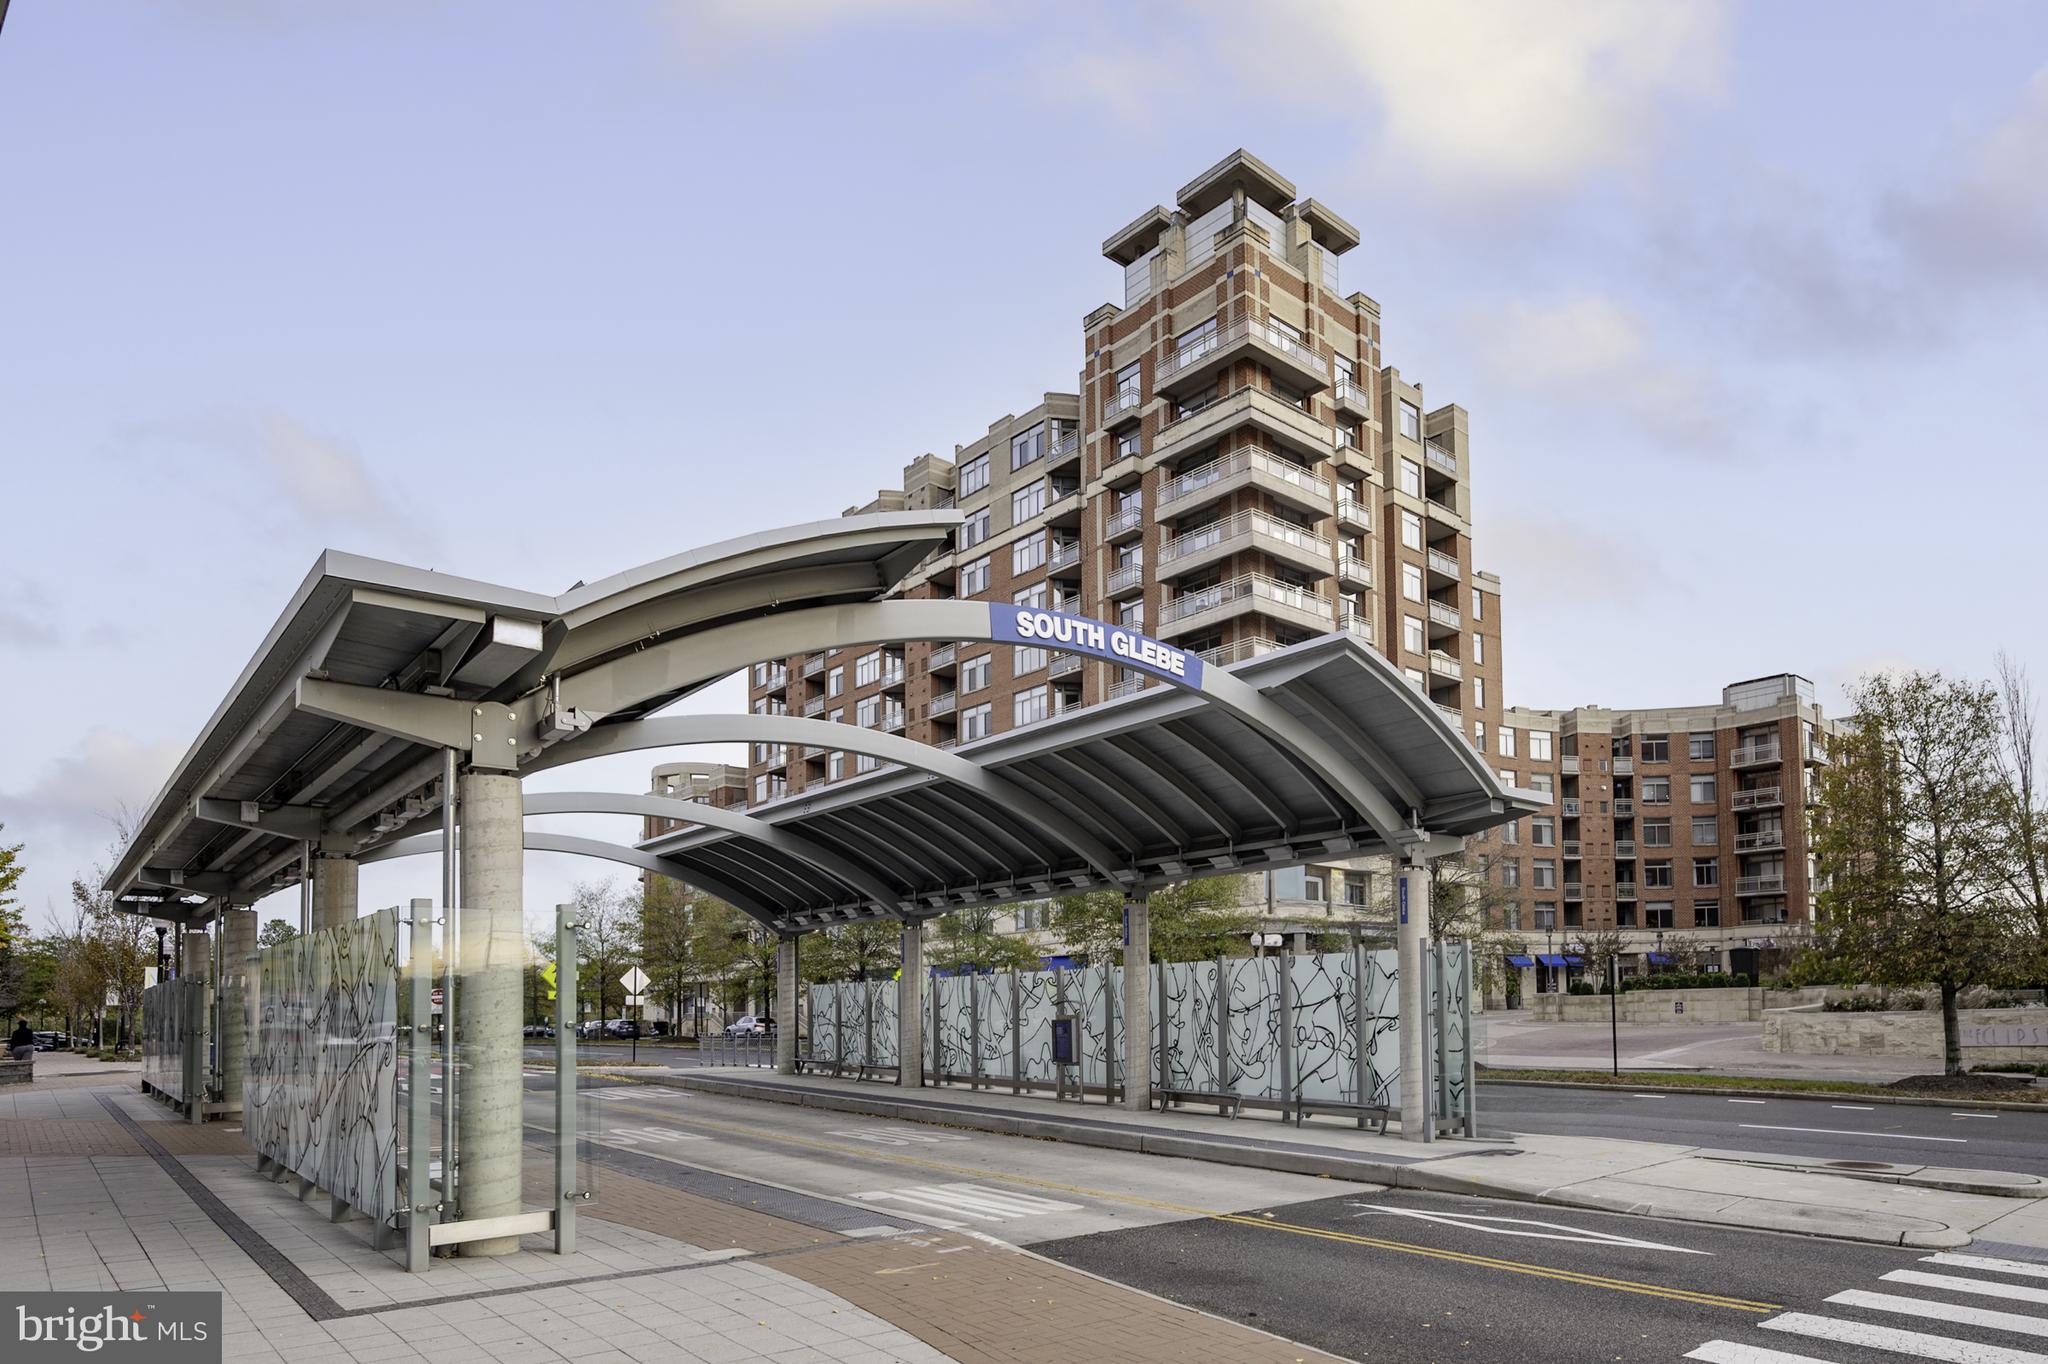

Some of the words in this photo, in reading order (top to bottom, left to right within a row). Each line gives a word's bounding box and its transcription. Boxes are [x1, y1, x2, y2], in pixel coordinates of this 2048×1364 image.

[1016, 611, 1105, 650] SOUTH
[1111, 631, 1186, 677] GLEBE
[824, 1127, 971, 1146] BUS
